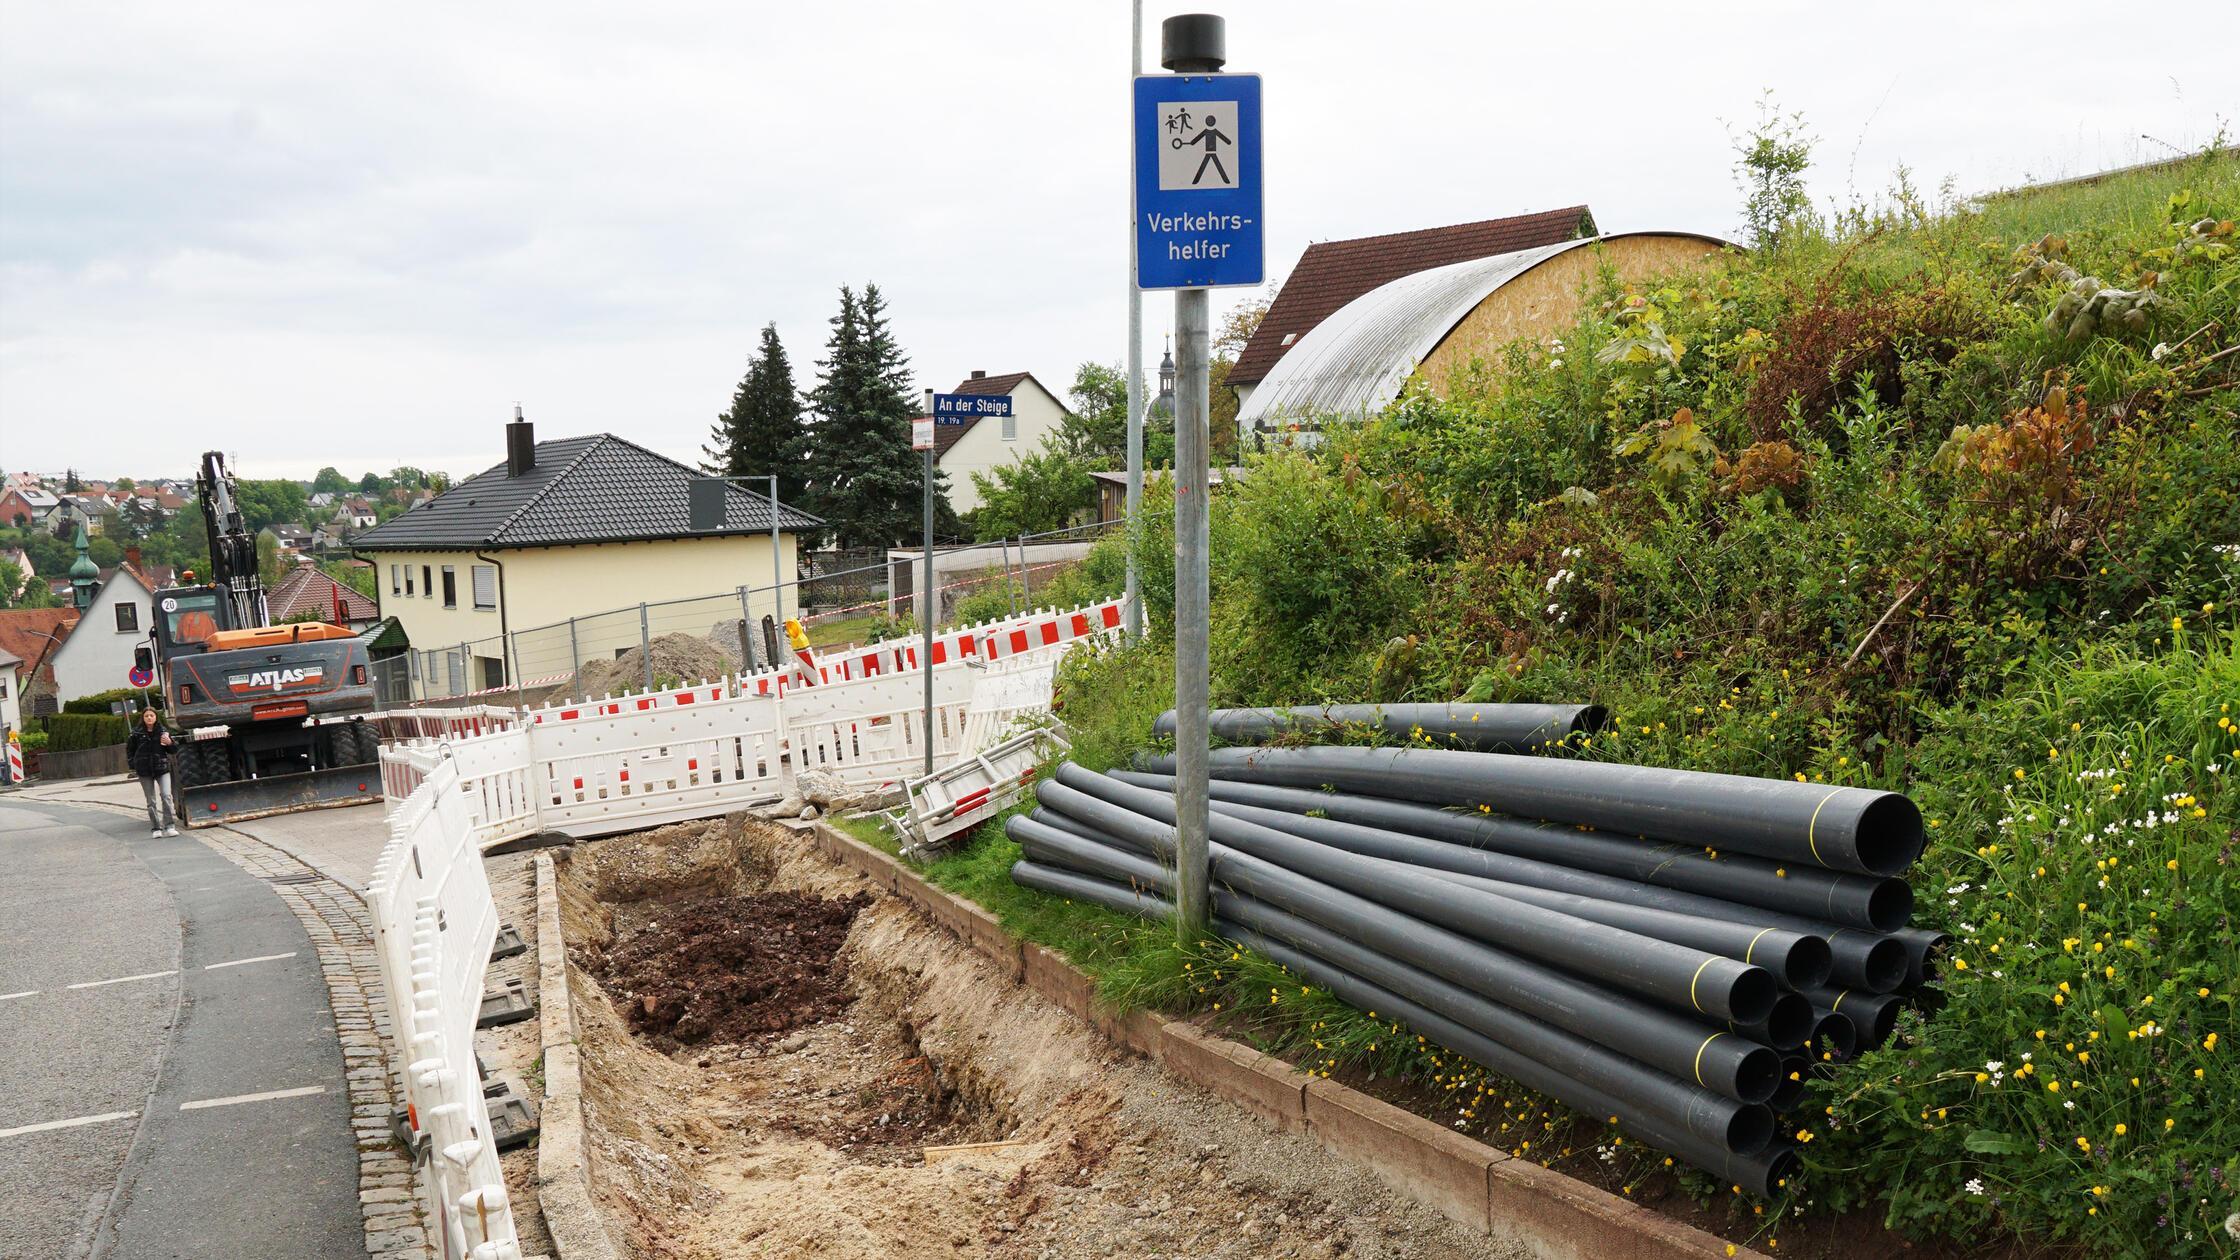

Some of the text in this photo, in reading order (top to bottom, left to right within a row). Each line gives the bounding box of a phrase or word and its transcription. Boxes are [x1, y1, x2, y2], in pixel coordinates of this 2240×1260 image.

[1147, 211, 1253, 233] Verkehrs-
[1168, 240, 1231, 260] helfer
[939, 397, 1008, 416] An der Steige
[164, 600, 175, 610] 20
[249, 668, 304, 687] ATLAS
